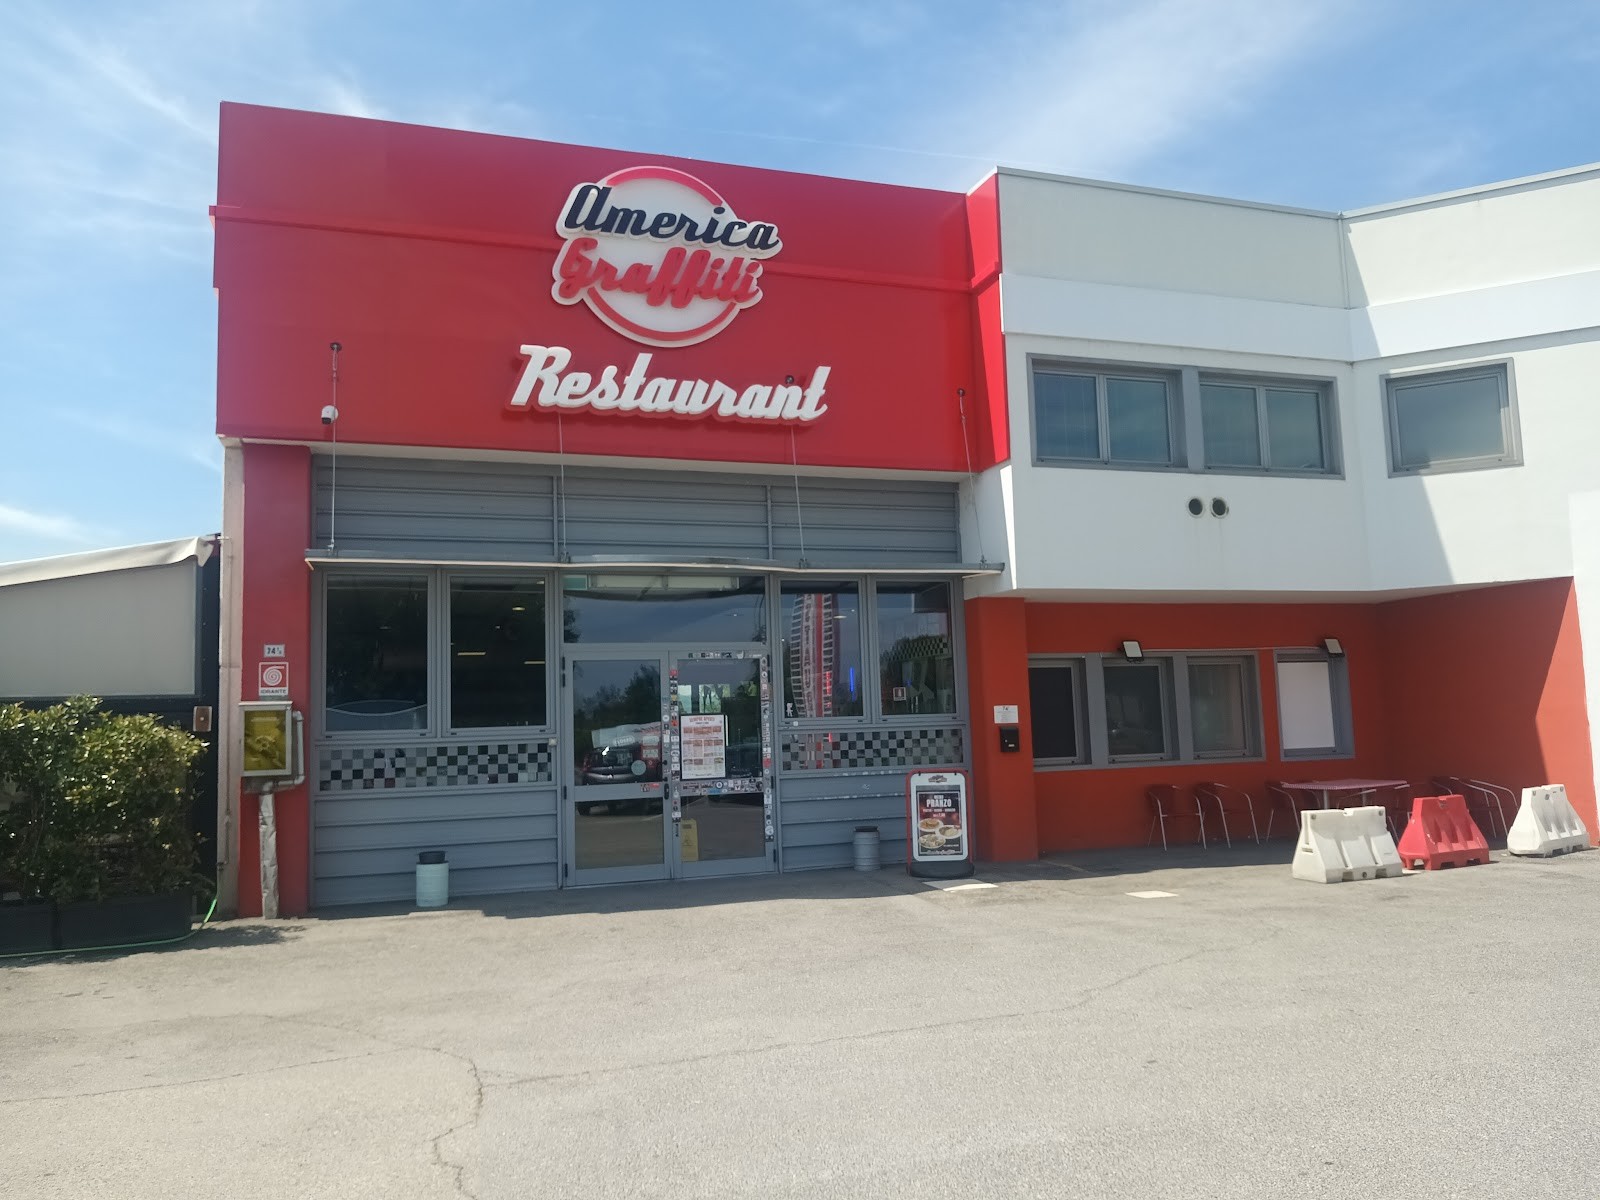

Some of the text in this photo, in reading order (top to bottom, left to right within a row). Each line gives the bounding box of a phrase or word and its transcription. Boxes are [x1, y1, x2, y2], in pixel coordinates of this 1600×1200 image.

[564, 185, 779, 250] America
[558, 238, 760, 309] Graffiti
[510, 344, 832, 421] Restaurant
[926, 798, 952, 808] PRANZO
